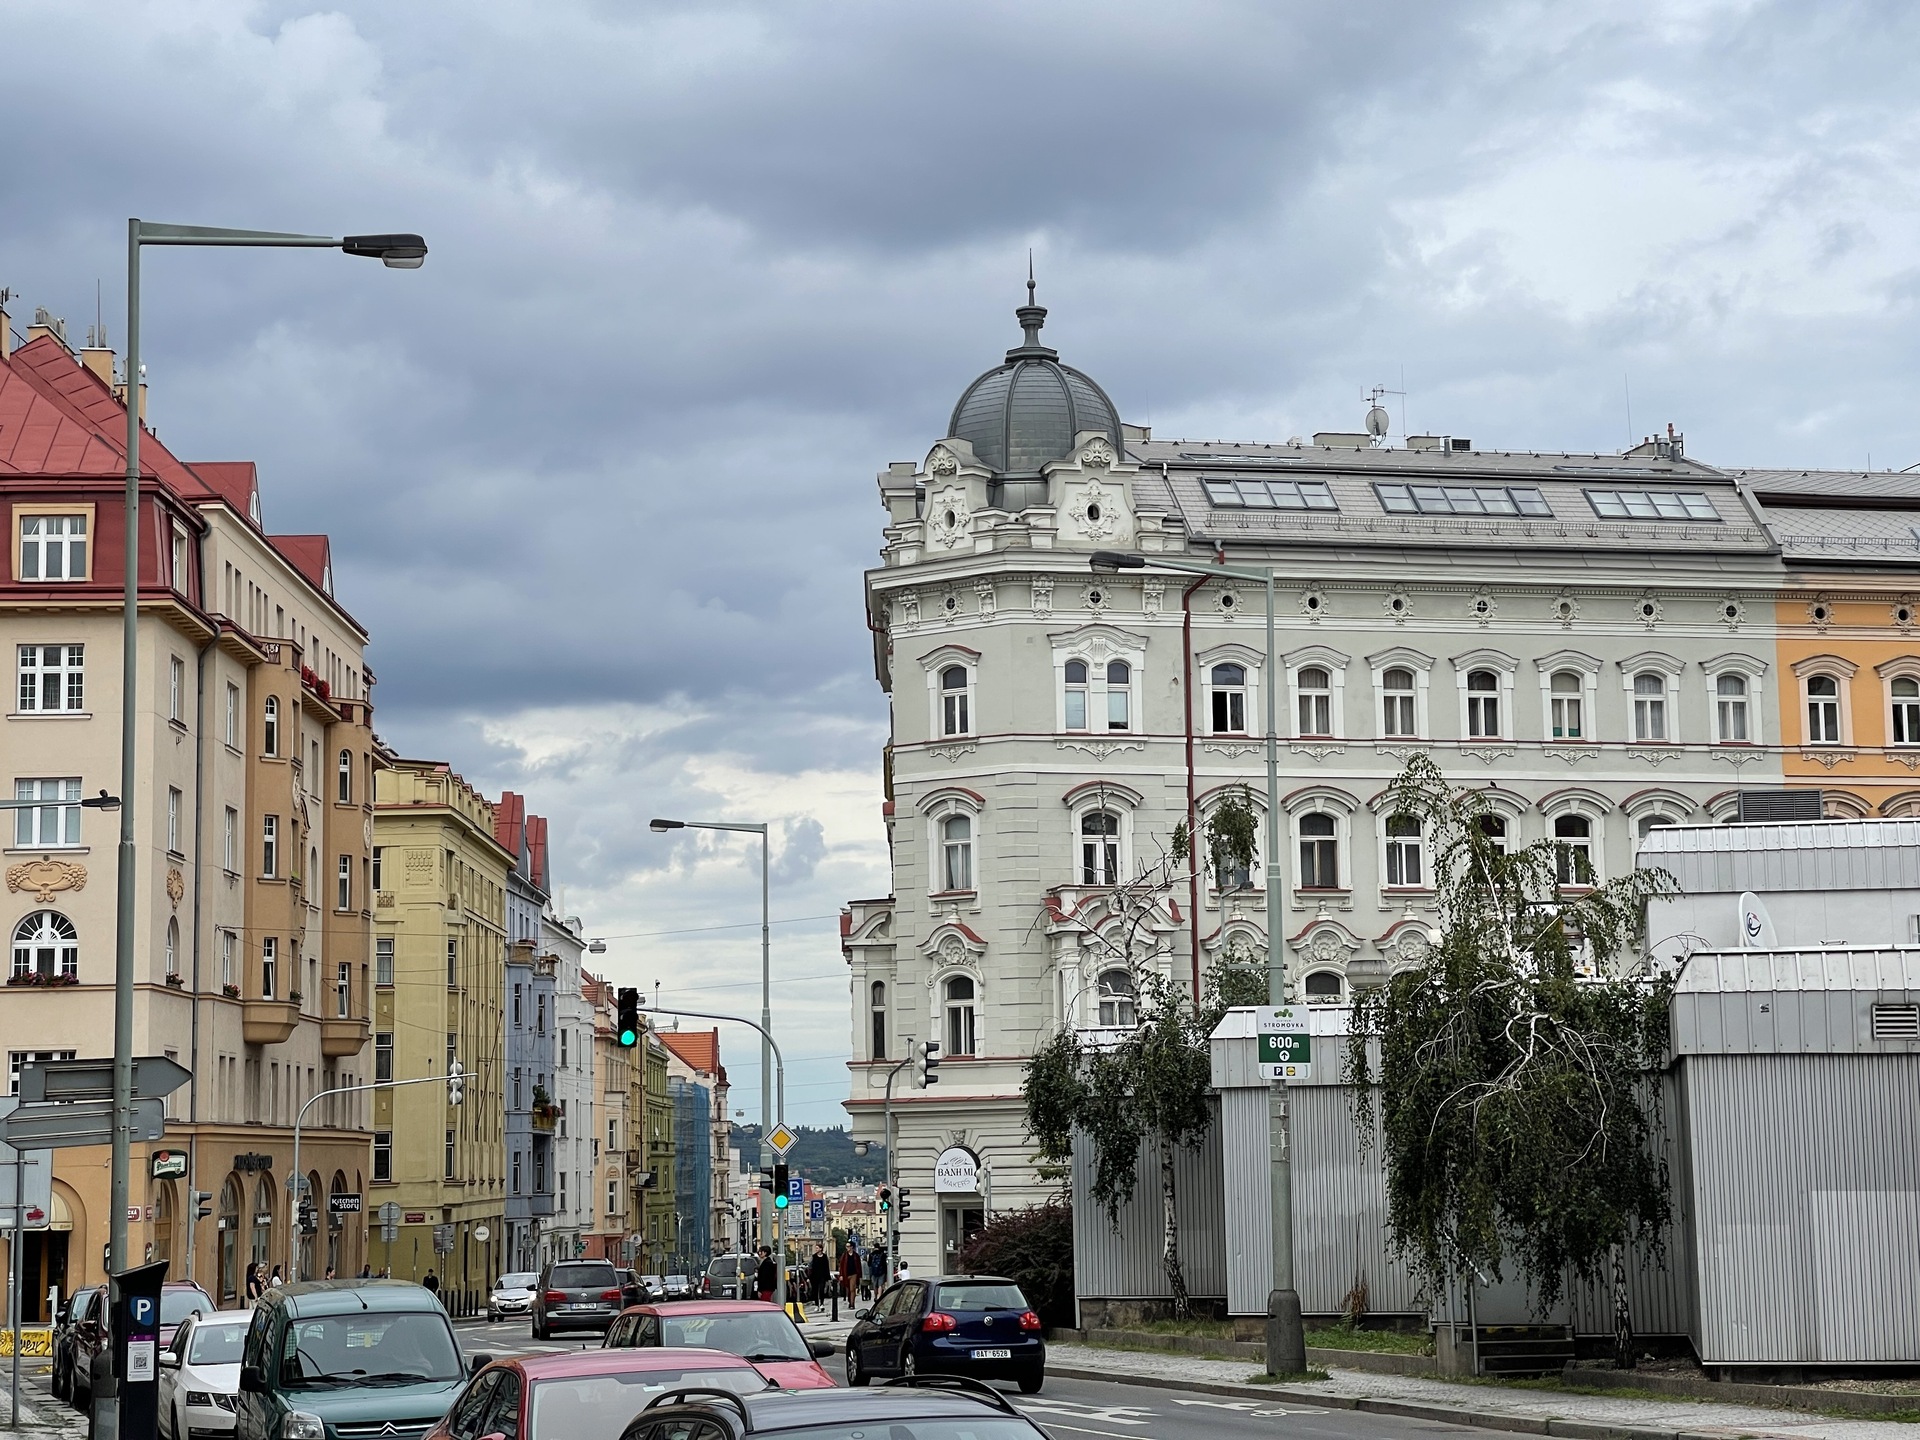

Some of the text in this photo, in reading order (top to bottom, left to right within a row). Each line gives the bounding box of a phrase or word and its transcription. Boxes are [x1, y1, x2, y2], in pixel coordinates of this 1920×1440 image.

[1276, 1067, 1281, 1075] P
[789, 1180, 800, 1196] P
[943, 1177, 970, 1188] MAKERS
[339, 1203, 360, 1211] story
[812, 1201, 821, 1214] P
[136, 1299, 151, 1321] P
[992, 1350, 1008, 1358] 6528
